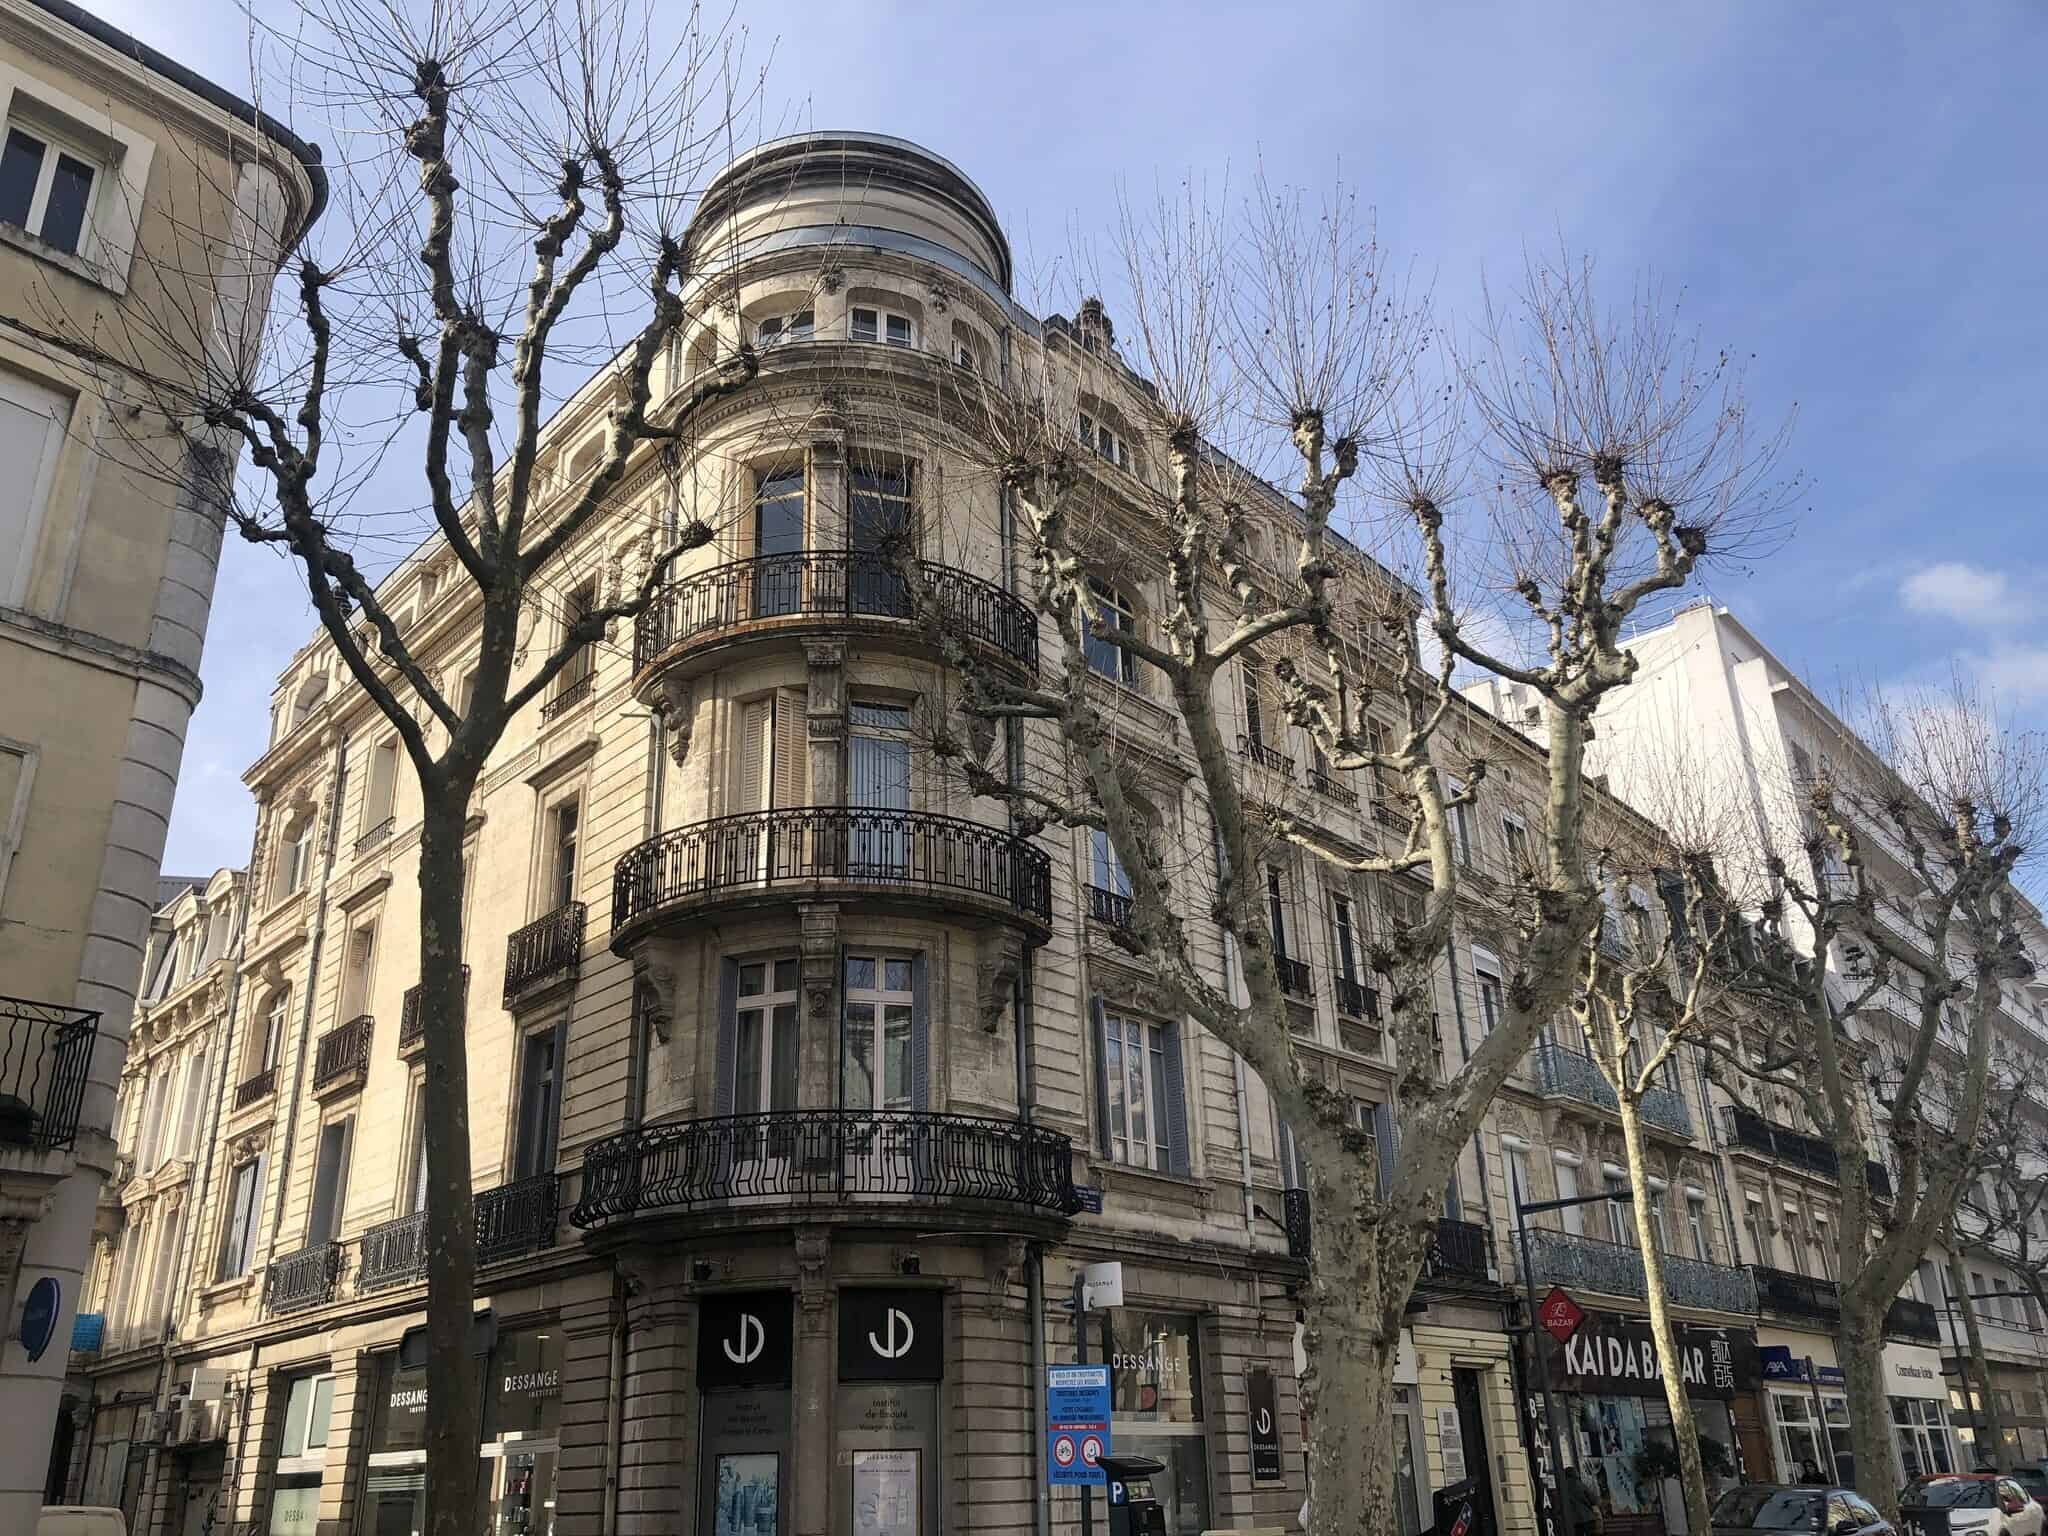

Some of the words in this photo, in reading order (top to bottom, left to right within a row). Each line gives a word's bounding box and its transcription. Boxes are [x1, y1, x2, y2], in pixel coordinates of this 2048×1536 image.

[1547, 1319, 1574, 1328] BAZAR
[1112, 1352, 1181, 1372] DESSANGE
[1640, 1340, 1707, 1385] BAAR
[1766, 1361, 1788, 1373] AXA
[504, 1370, 558, 1392] DESSANGE
[390, 1389, 428, 1408] DESSANG
[1112, 1481, 1122, 1503] P
